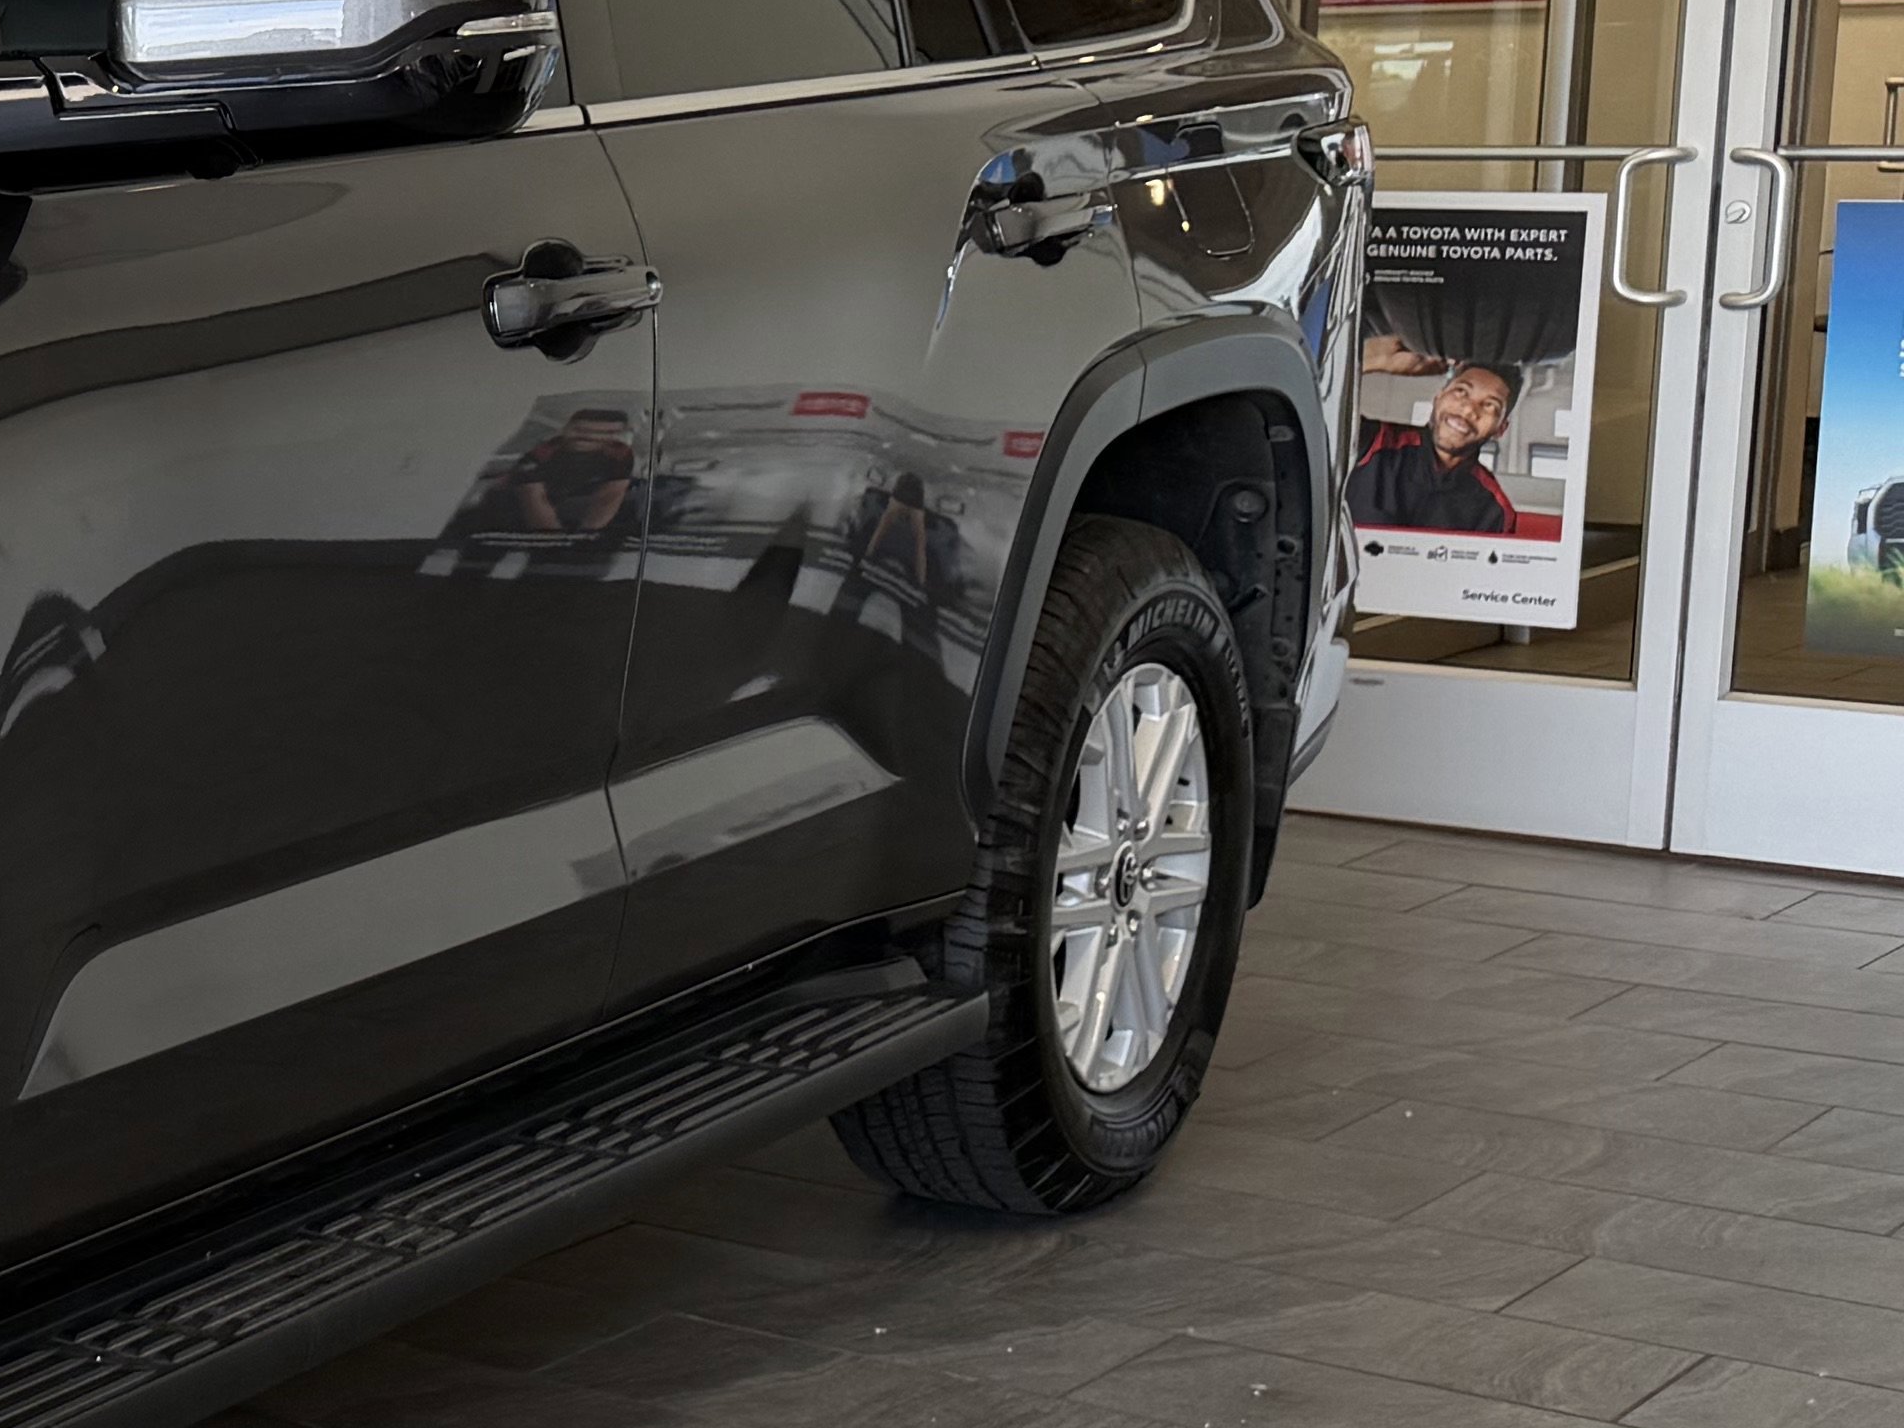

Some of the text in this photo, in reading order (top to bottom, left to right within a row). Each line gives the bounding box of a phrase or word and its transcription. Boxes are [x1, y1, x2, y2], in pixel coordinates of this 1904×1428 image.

[1386, 226, 1398, 239] A
[1401, 226, 1461, 241] TOYOTA
[1464, 228, 1505, 241] WITH
[1510, 229, 1568, 243] EXPERT
[1367, 244, 1558, 261] GENUINE TOYOTA PARTS.
[1462, 589, 1557, 607] Service Center
[1127, 598, 1216, 650] MICHELIN
